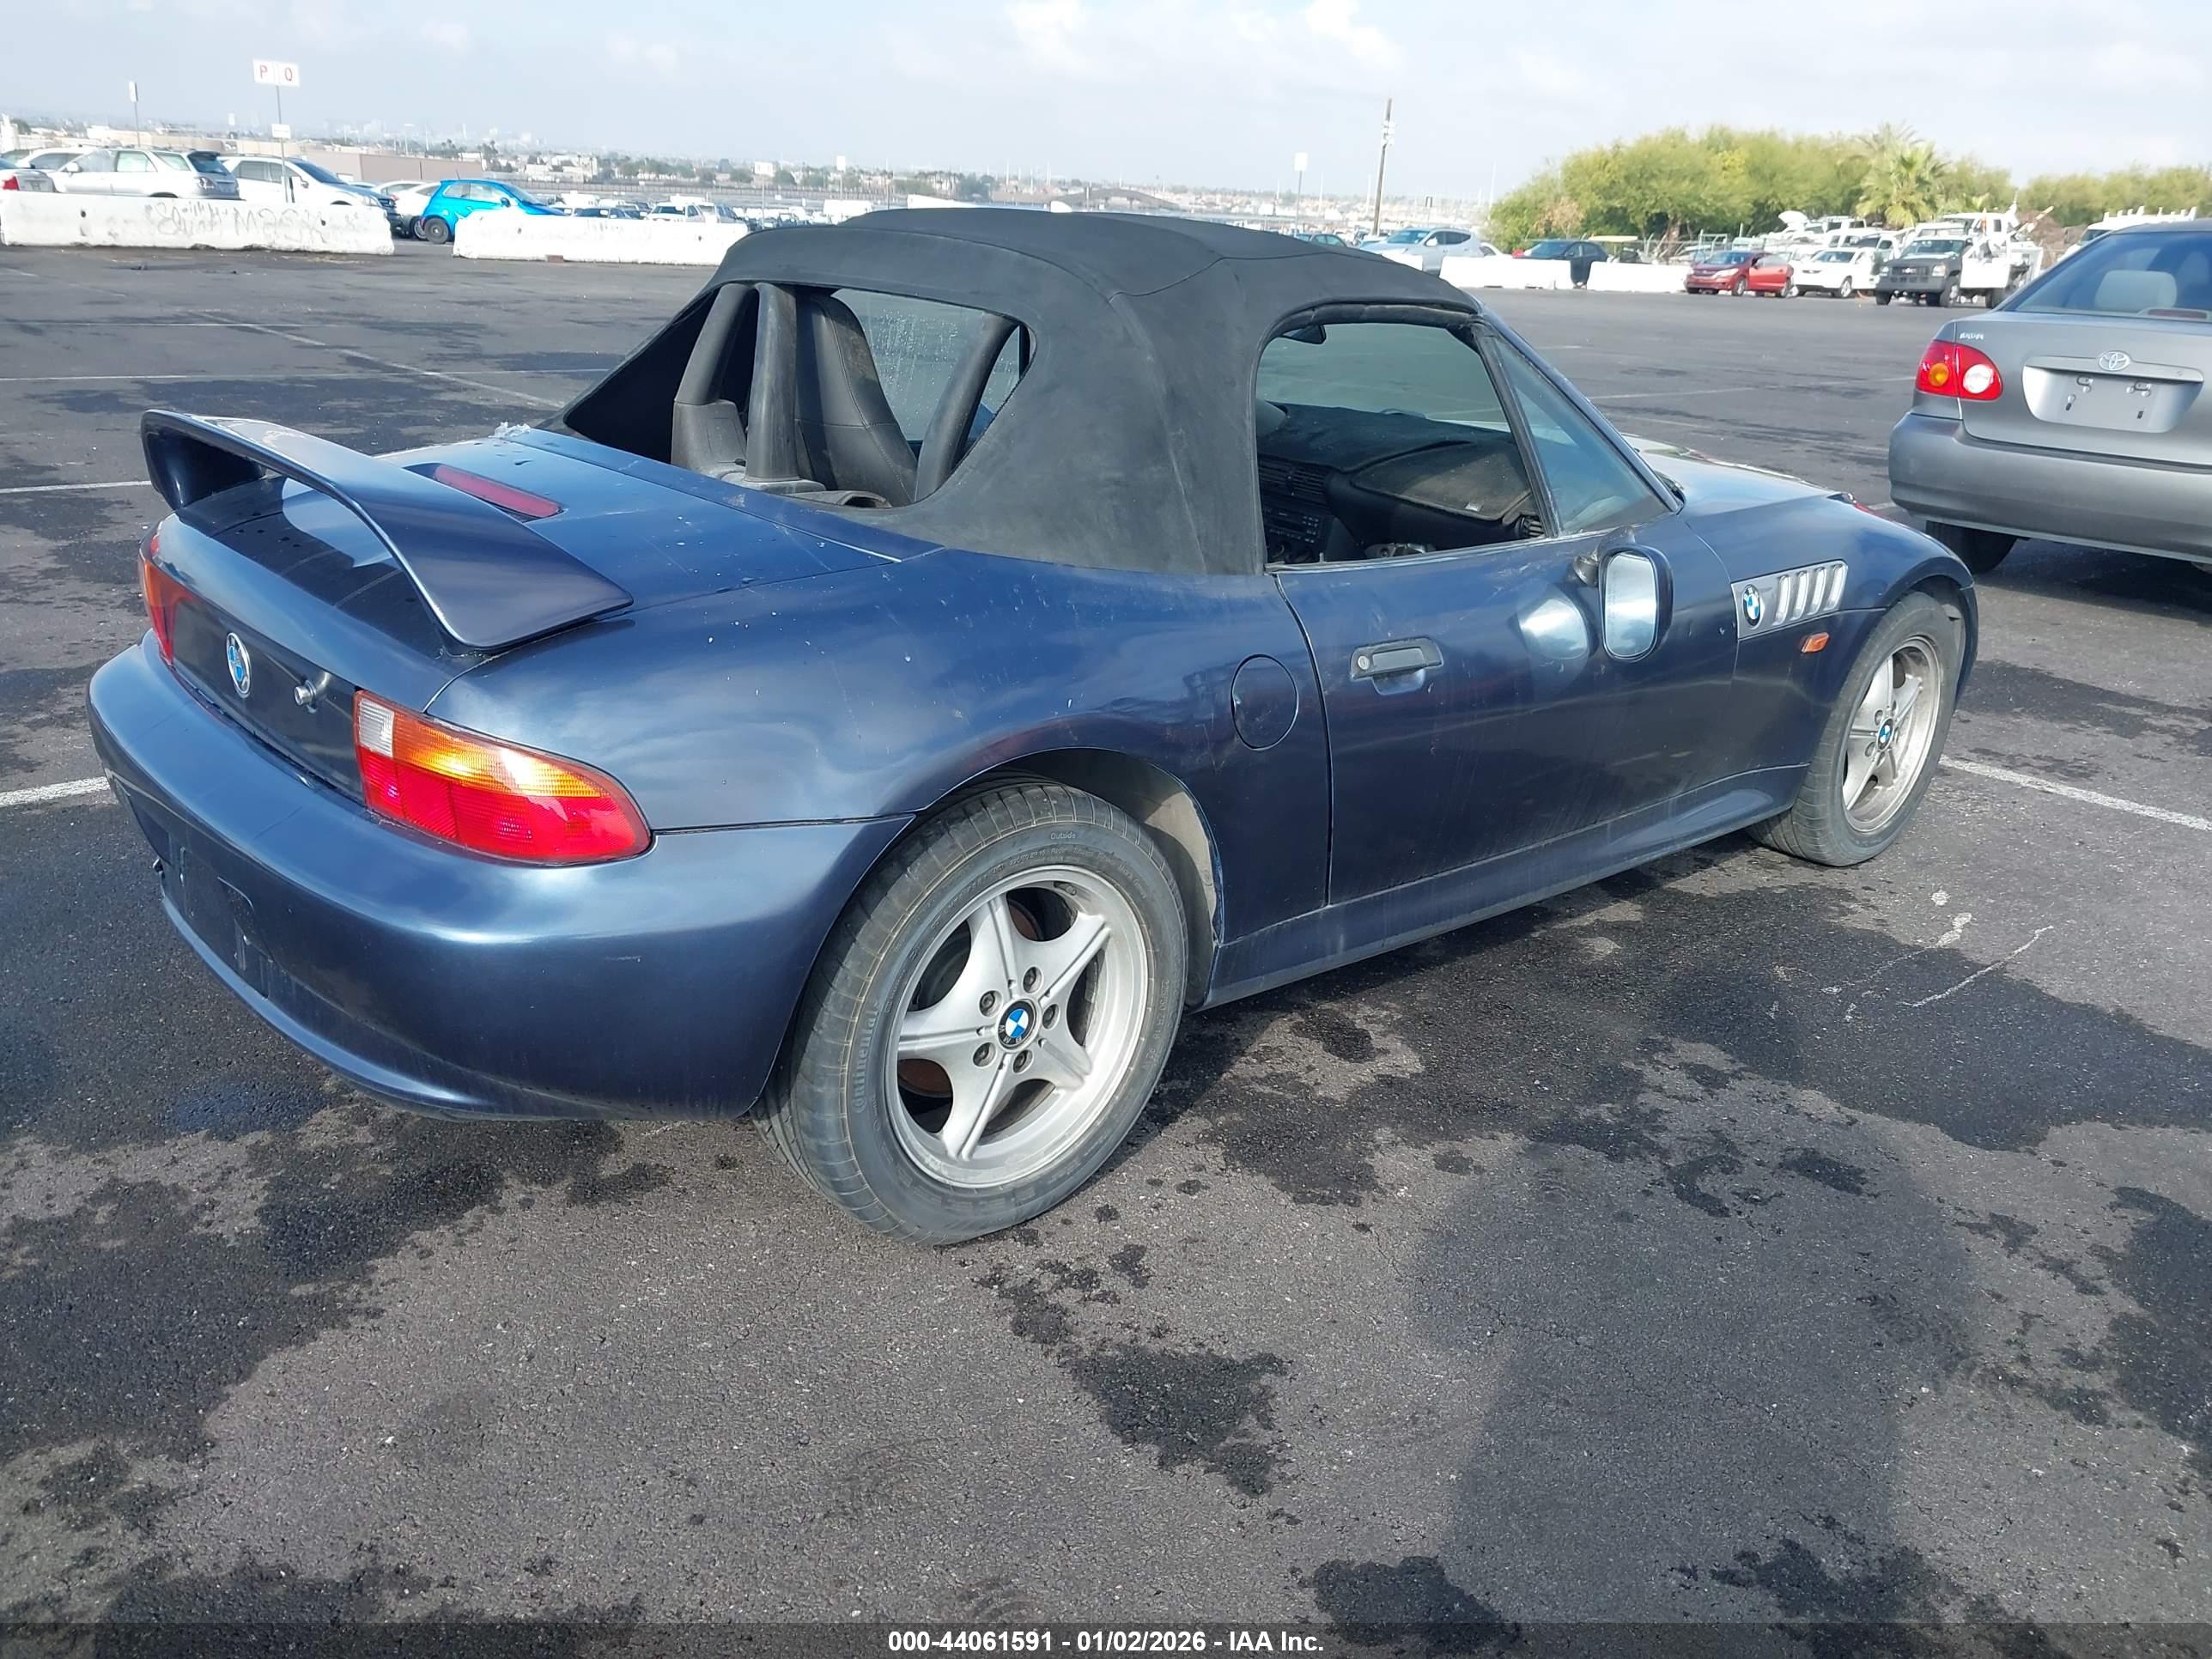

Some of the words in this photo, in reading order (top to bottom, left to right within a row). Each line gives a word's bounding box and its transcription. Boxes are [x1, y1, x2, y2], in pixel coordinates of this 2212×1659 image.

[259, 64, 268, 79] P
[1050, 830, 1077, 840] Outside
[852, 1008, 879, 1114] Continental
